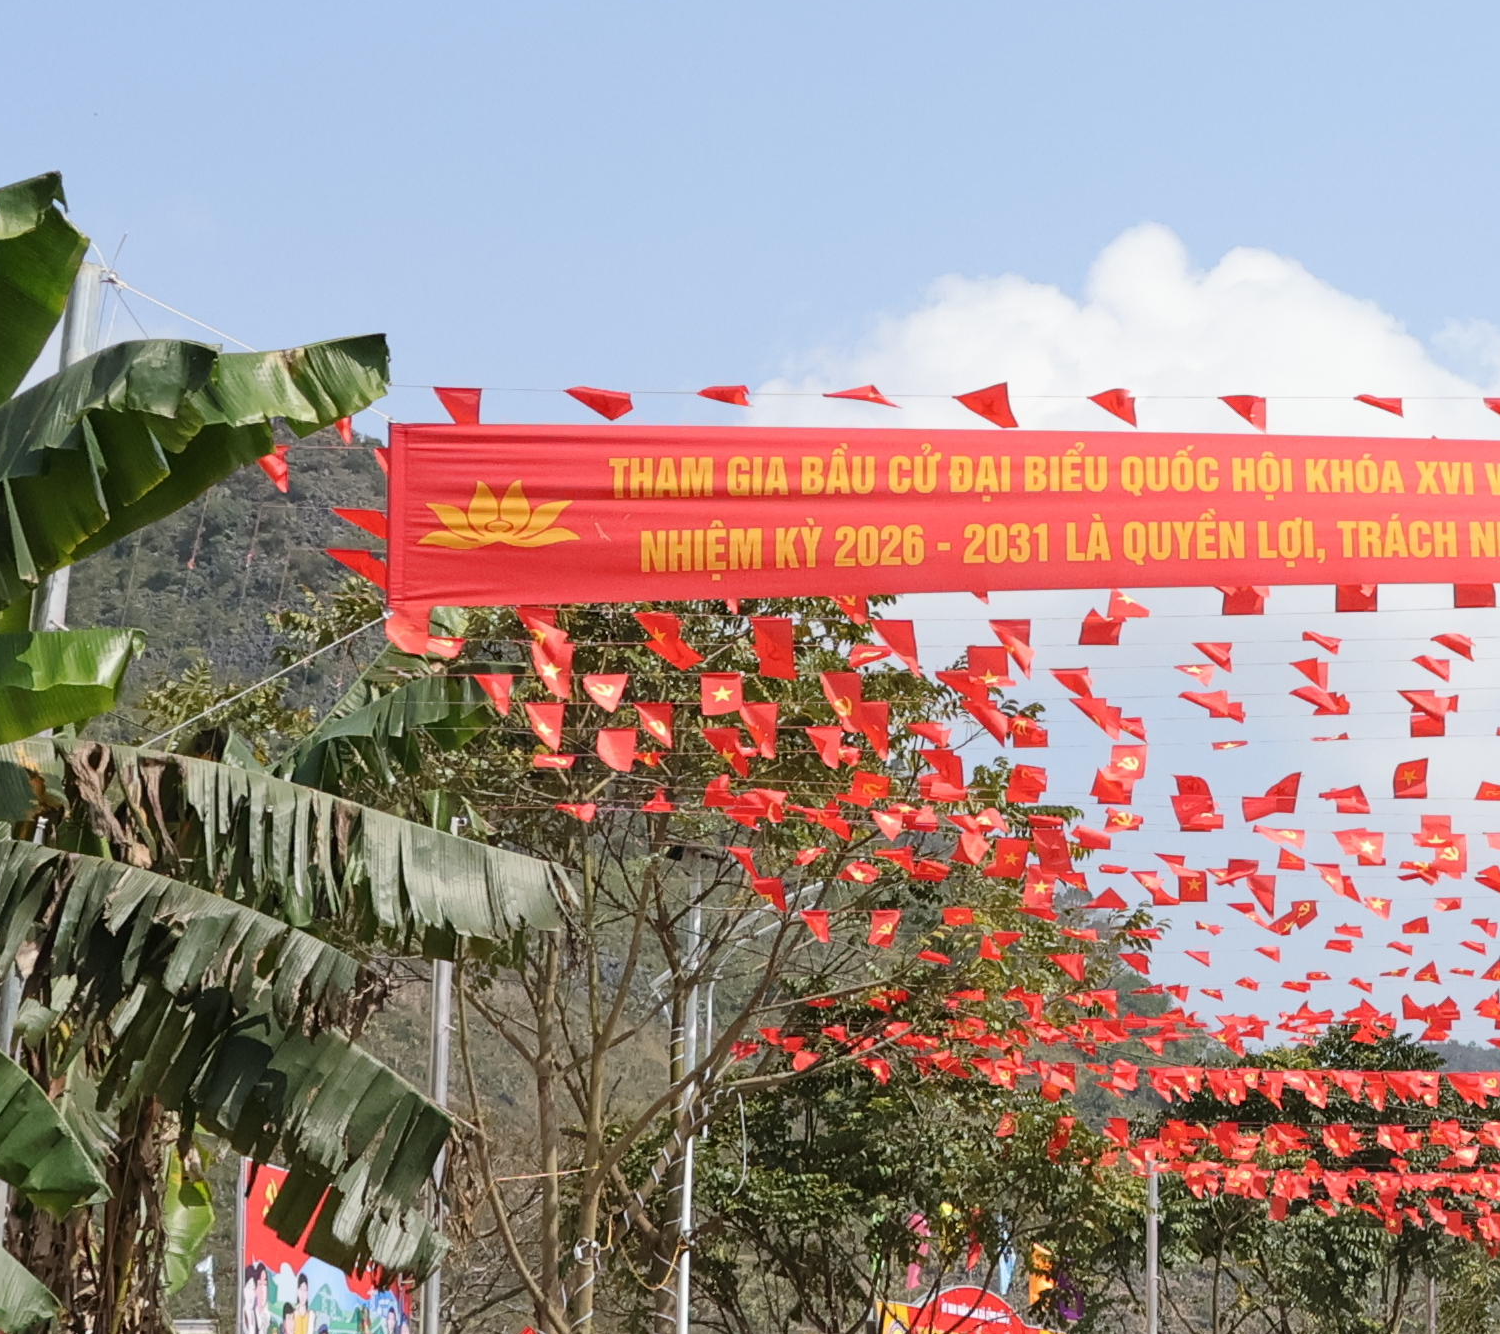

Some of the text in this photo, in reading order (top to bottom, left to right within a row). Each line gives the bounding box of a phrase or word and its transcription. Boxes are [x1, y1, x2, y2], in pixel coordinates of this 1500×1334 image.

[609, 455, 714, 499] THAM
[727, 455, 789, 496] GIA
[800, 442, 876, 495] BẦU
[888, 443, 942, 494] CỬ
[949, 455, 1011, 502] ĐẠI
[1025, 442, 1108, 492] BIỂU
[1121, 445, 1220, 497] QUỐC
[1232, 451, 1293, 501] HỘI
[1306, 453, 1405, 494] KHÓA
[1415, 460, 1475, 495] XVI
[641, 519, 763, 581] NHIỆM
[775, 517, 823, 569] KỲ
[834, 524, 925, 567] 2026
[937, 540, 951, 551] -
[963, 523, 1048, 564] 2031
[1066, 513, 1112, 562] LÀ
[1123, 508, 1247, 566] QUYỀN
[1257, 517, 1326, 568] LỢI,
[1337, 513, 1457, 559] TRÁCH
